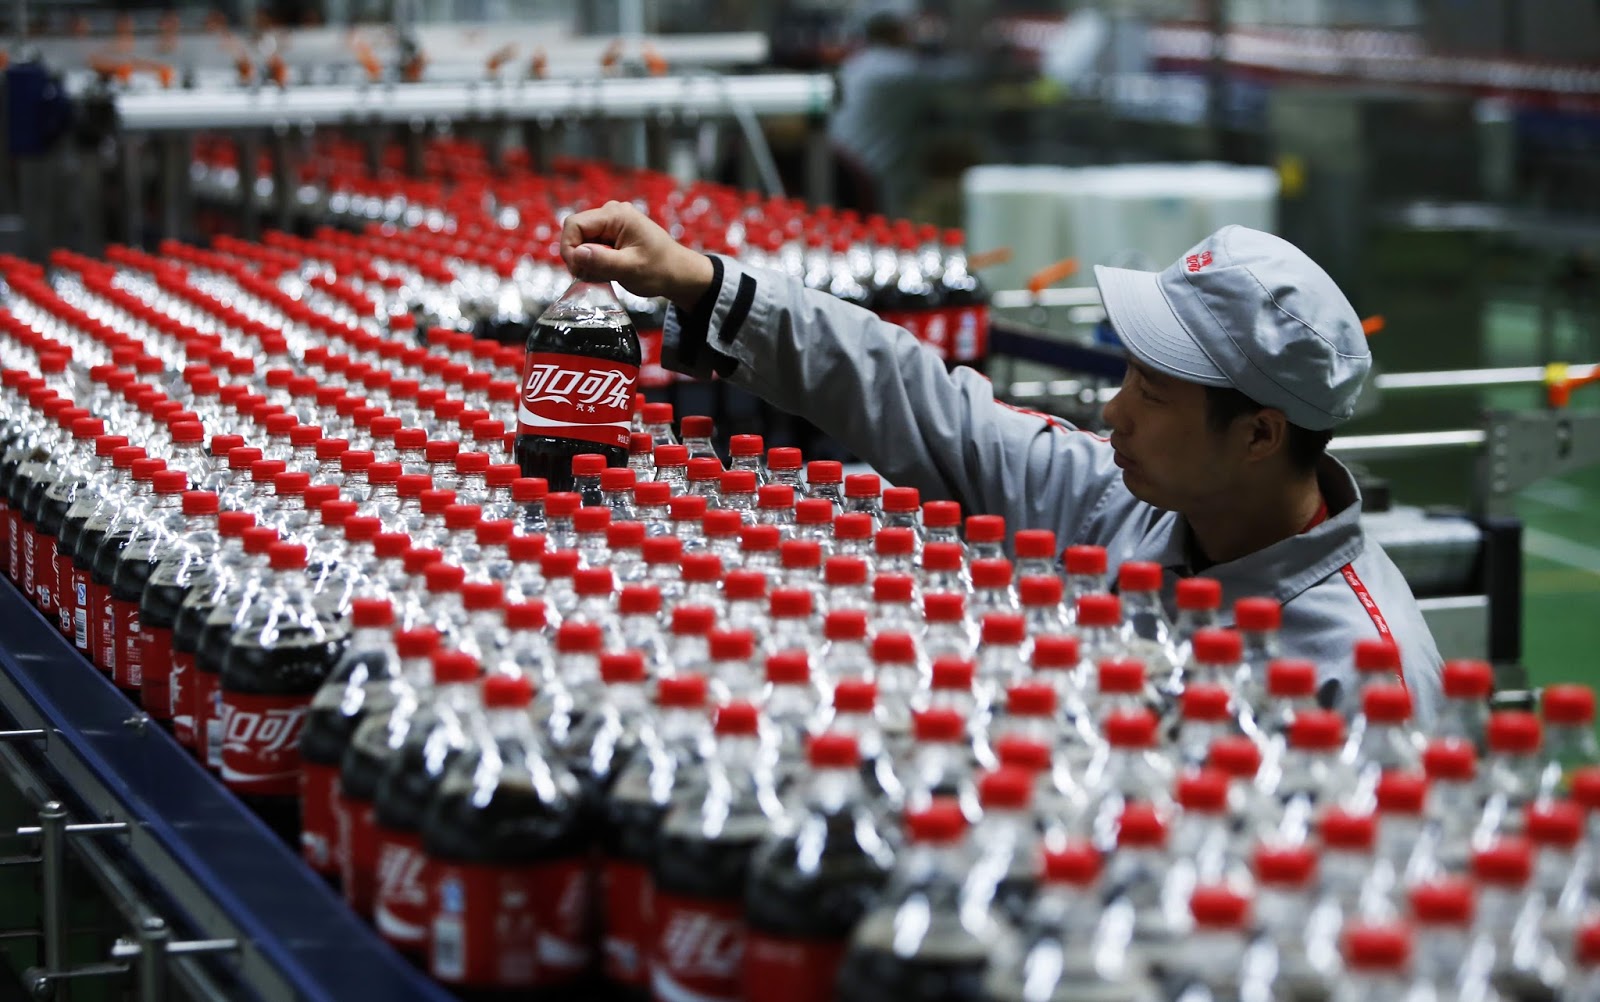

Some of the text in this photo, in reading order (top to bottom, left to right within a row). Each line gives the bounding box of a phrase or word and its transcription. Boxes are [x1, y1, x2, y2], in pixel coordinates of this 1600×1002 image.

[526, 364, 636, 409] 可口可乐
[576, 403, 596, 413] 汽水
